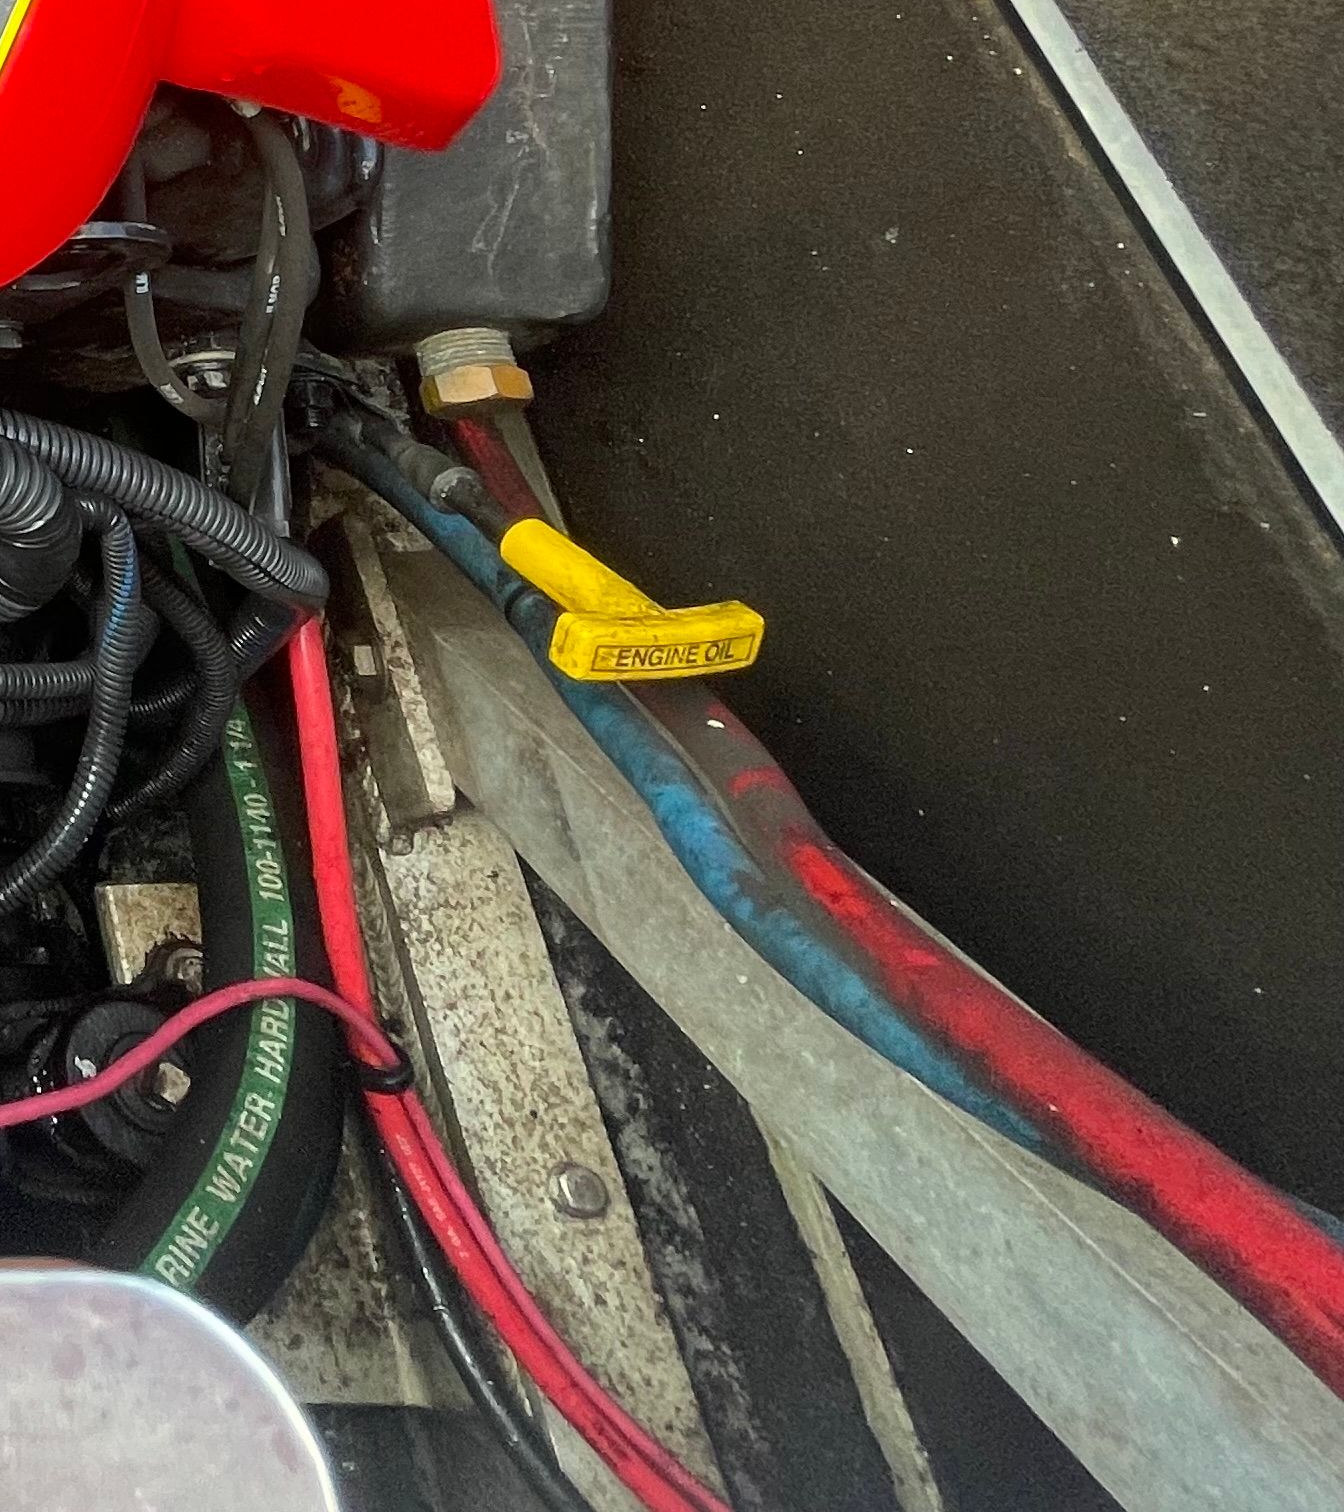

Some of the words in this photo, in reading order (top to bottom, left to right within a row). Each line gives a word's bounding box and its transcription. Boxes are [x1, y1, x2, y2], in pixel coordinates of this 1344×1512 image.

[615, 644, 698, 668] ENGINE
[705, 641, 734, 663] OIL
[206, 1092, 275, 1204] WATER
